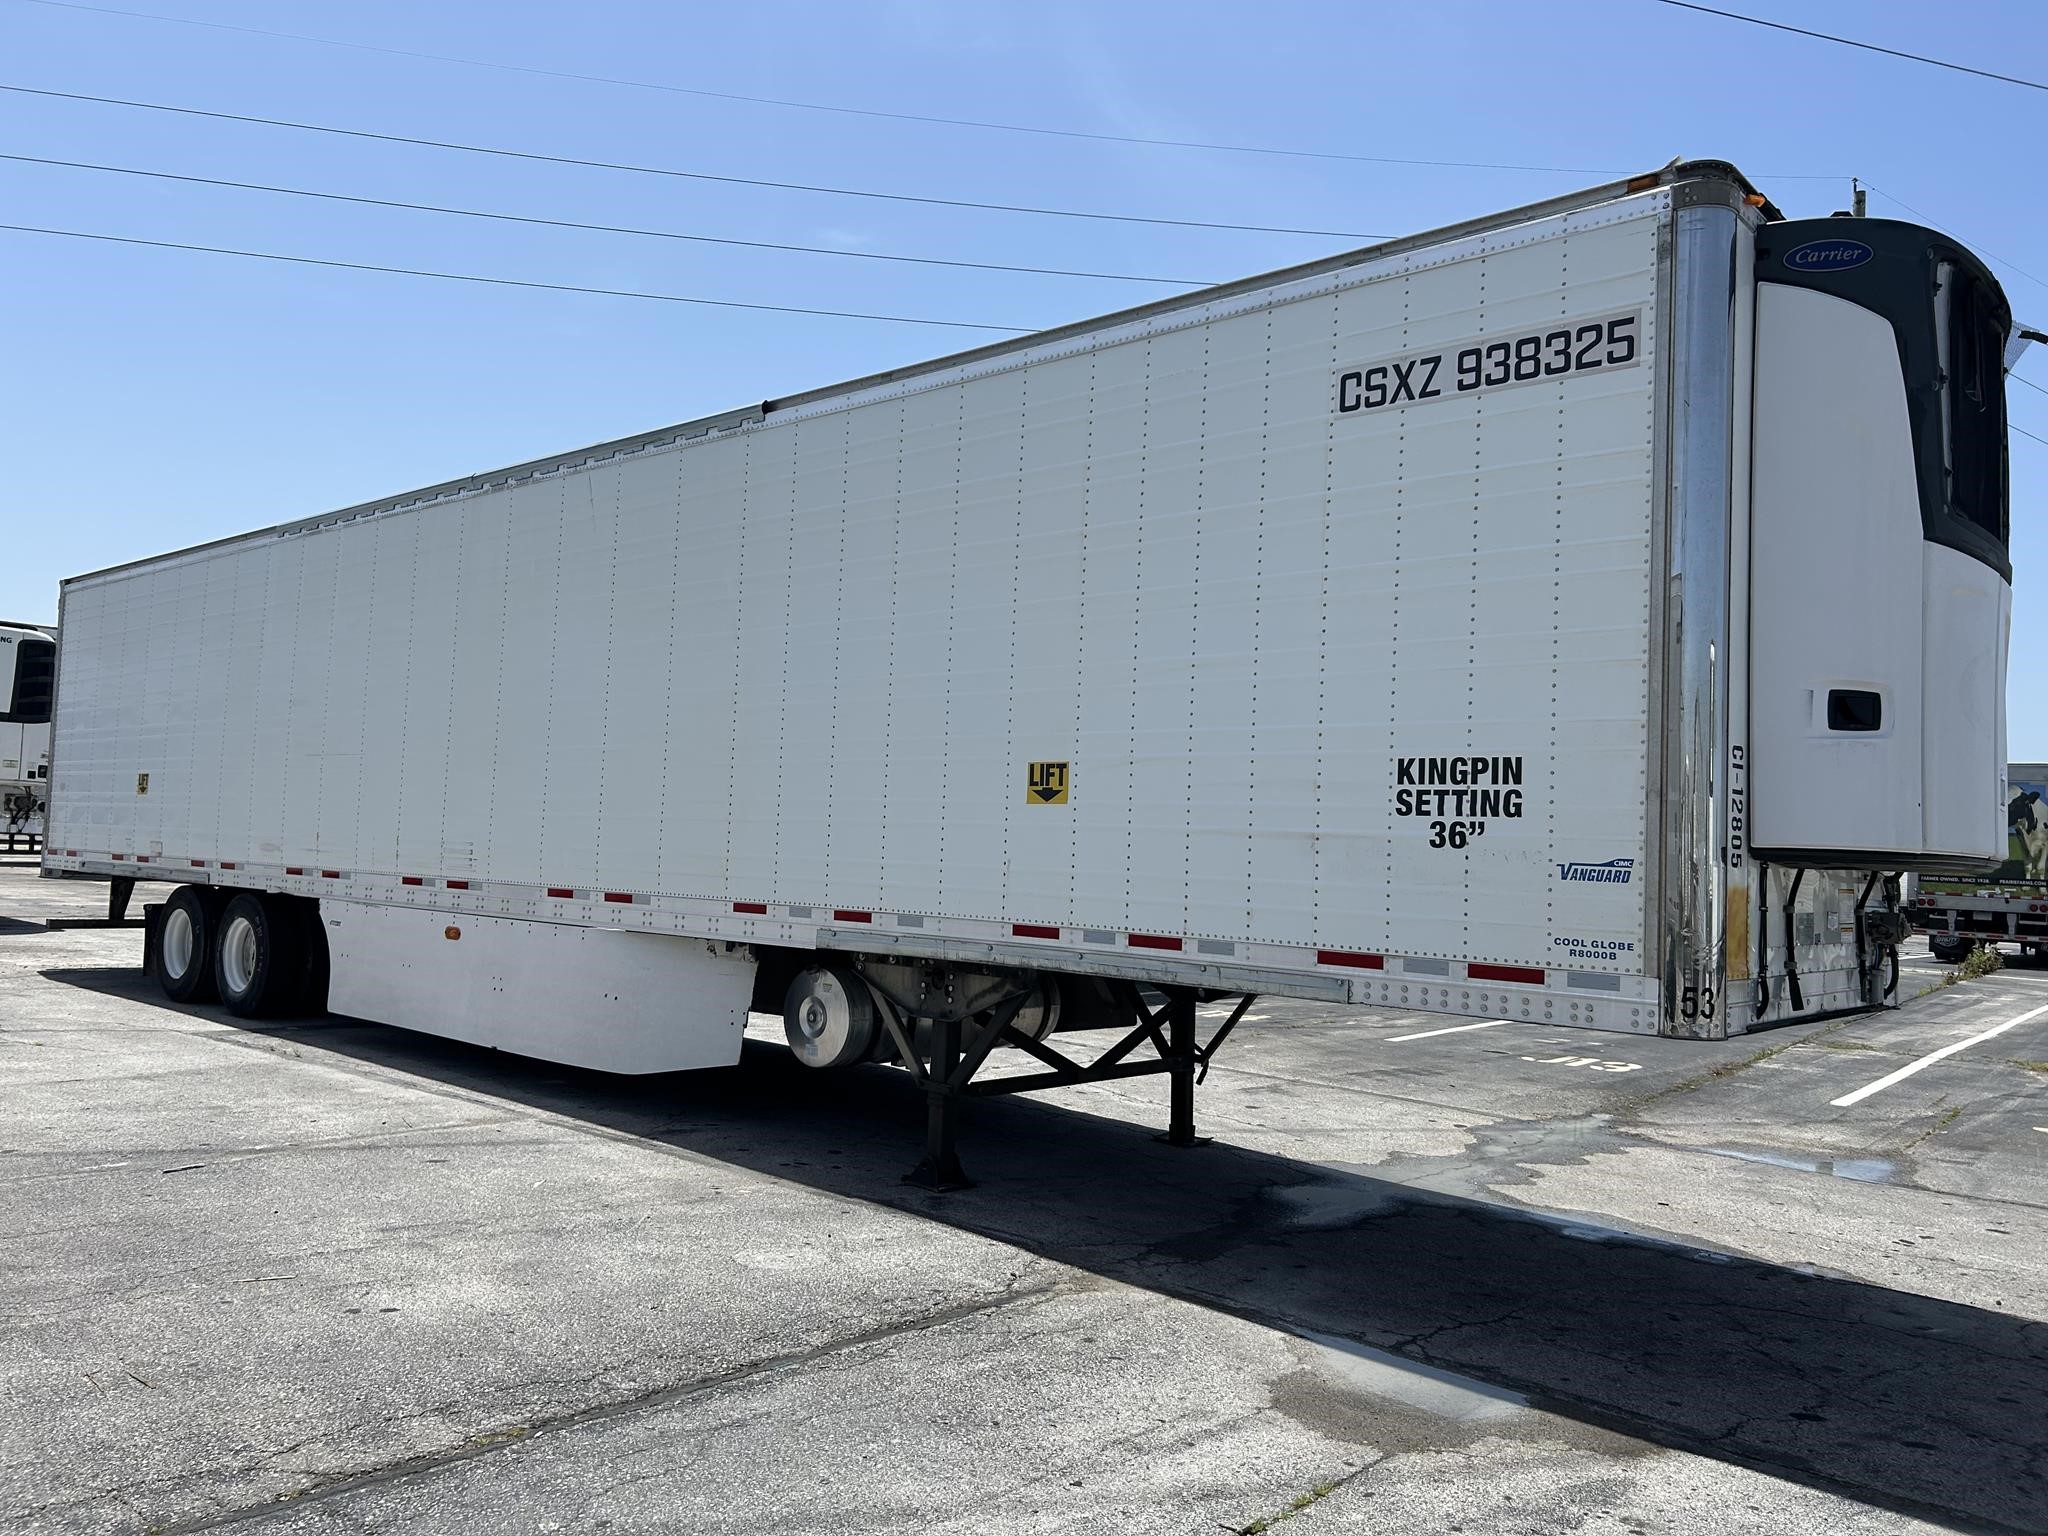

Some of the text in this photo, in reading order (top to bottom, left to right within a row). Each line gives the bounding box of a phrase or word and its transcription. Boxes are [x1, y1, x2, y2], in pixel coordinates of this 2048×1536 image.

[1795, 247, 1862, 263] Carrier
[1339, 316, 1635, 413] CSXZ 938325
[1029, 763, 1067, 786] LIFT
[1396, 756, 1523, 785] KINGPIN
[1394, 788, 1523, 818] SETTING
[1731, 744, 1744, 869] CI-12805
[1554, 937, 1635, 951] COOL GLOBE
[1569, 949, 1617, 960] R8000B
[1681, 986, 1715, 1019] 53
